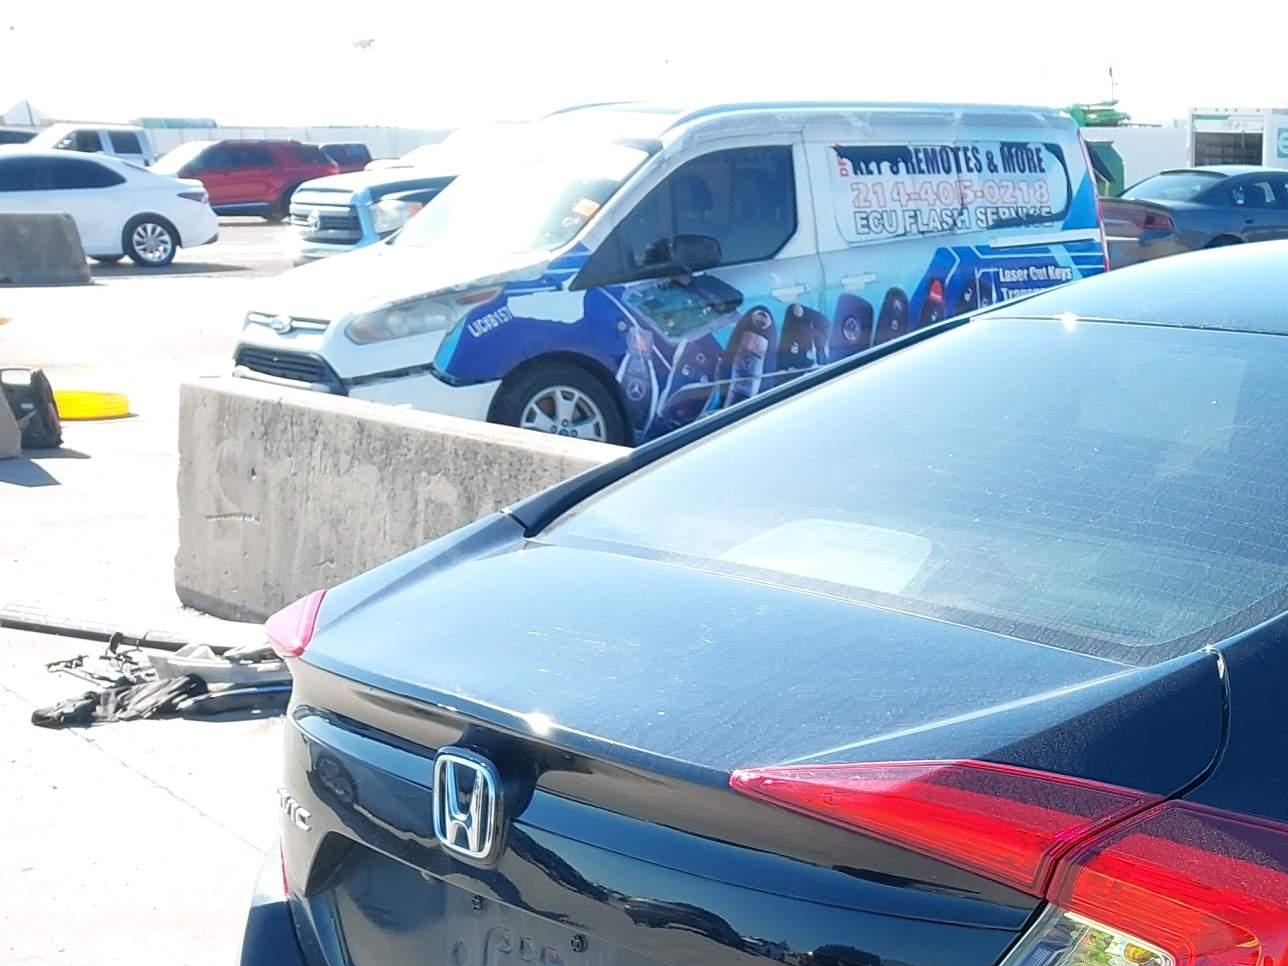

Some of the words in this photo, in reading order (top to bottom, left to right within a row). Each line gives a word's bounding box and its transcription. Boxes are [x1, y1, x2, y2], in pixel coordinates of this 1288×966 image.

[903, 145, 983, 175] REMOTES
[986, 151, 999, 173] &
[1000, 145, 1046, 174] MORE
[850, 180, 1049, 208] 214-405-0218
[853, 209, 899, 235] ECU
[903, 207, 971, 234] FLASH
[1000, 267, 1028, 282] Laser
[1029, 265, 1048, 281] Cut
[1048, 265, 1073, 281] Keys
